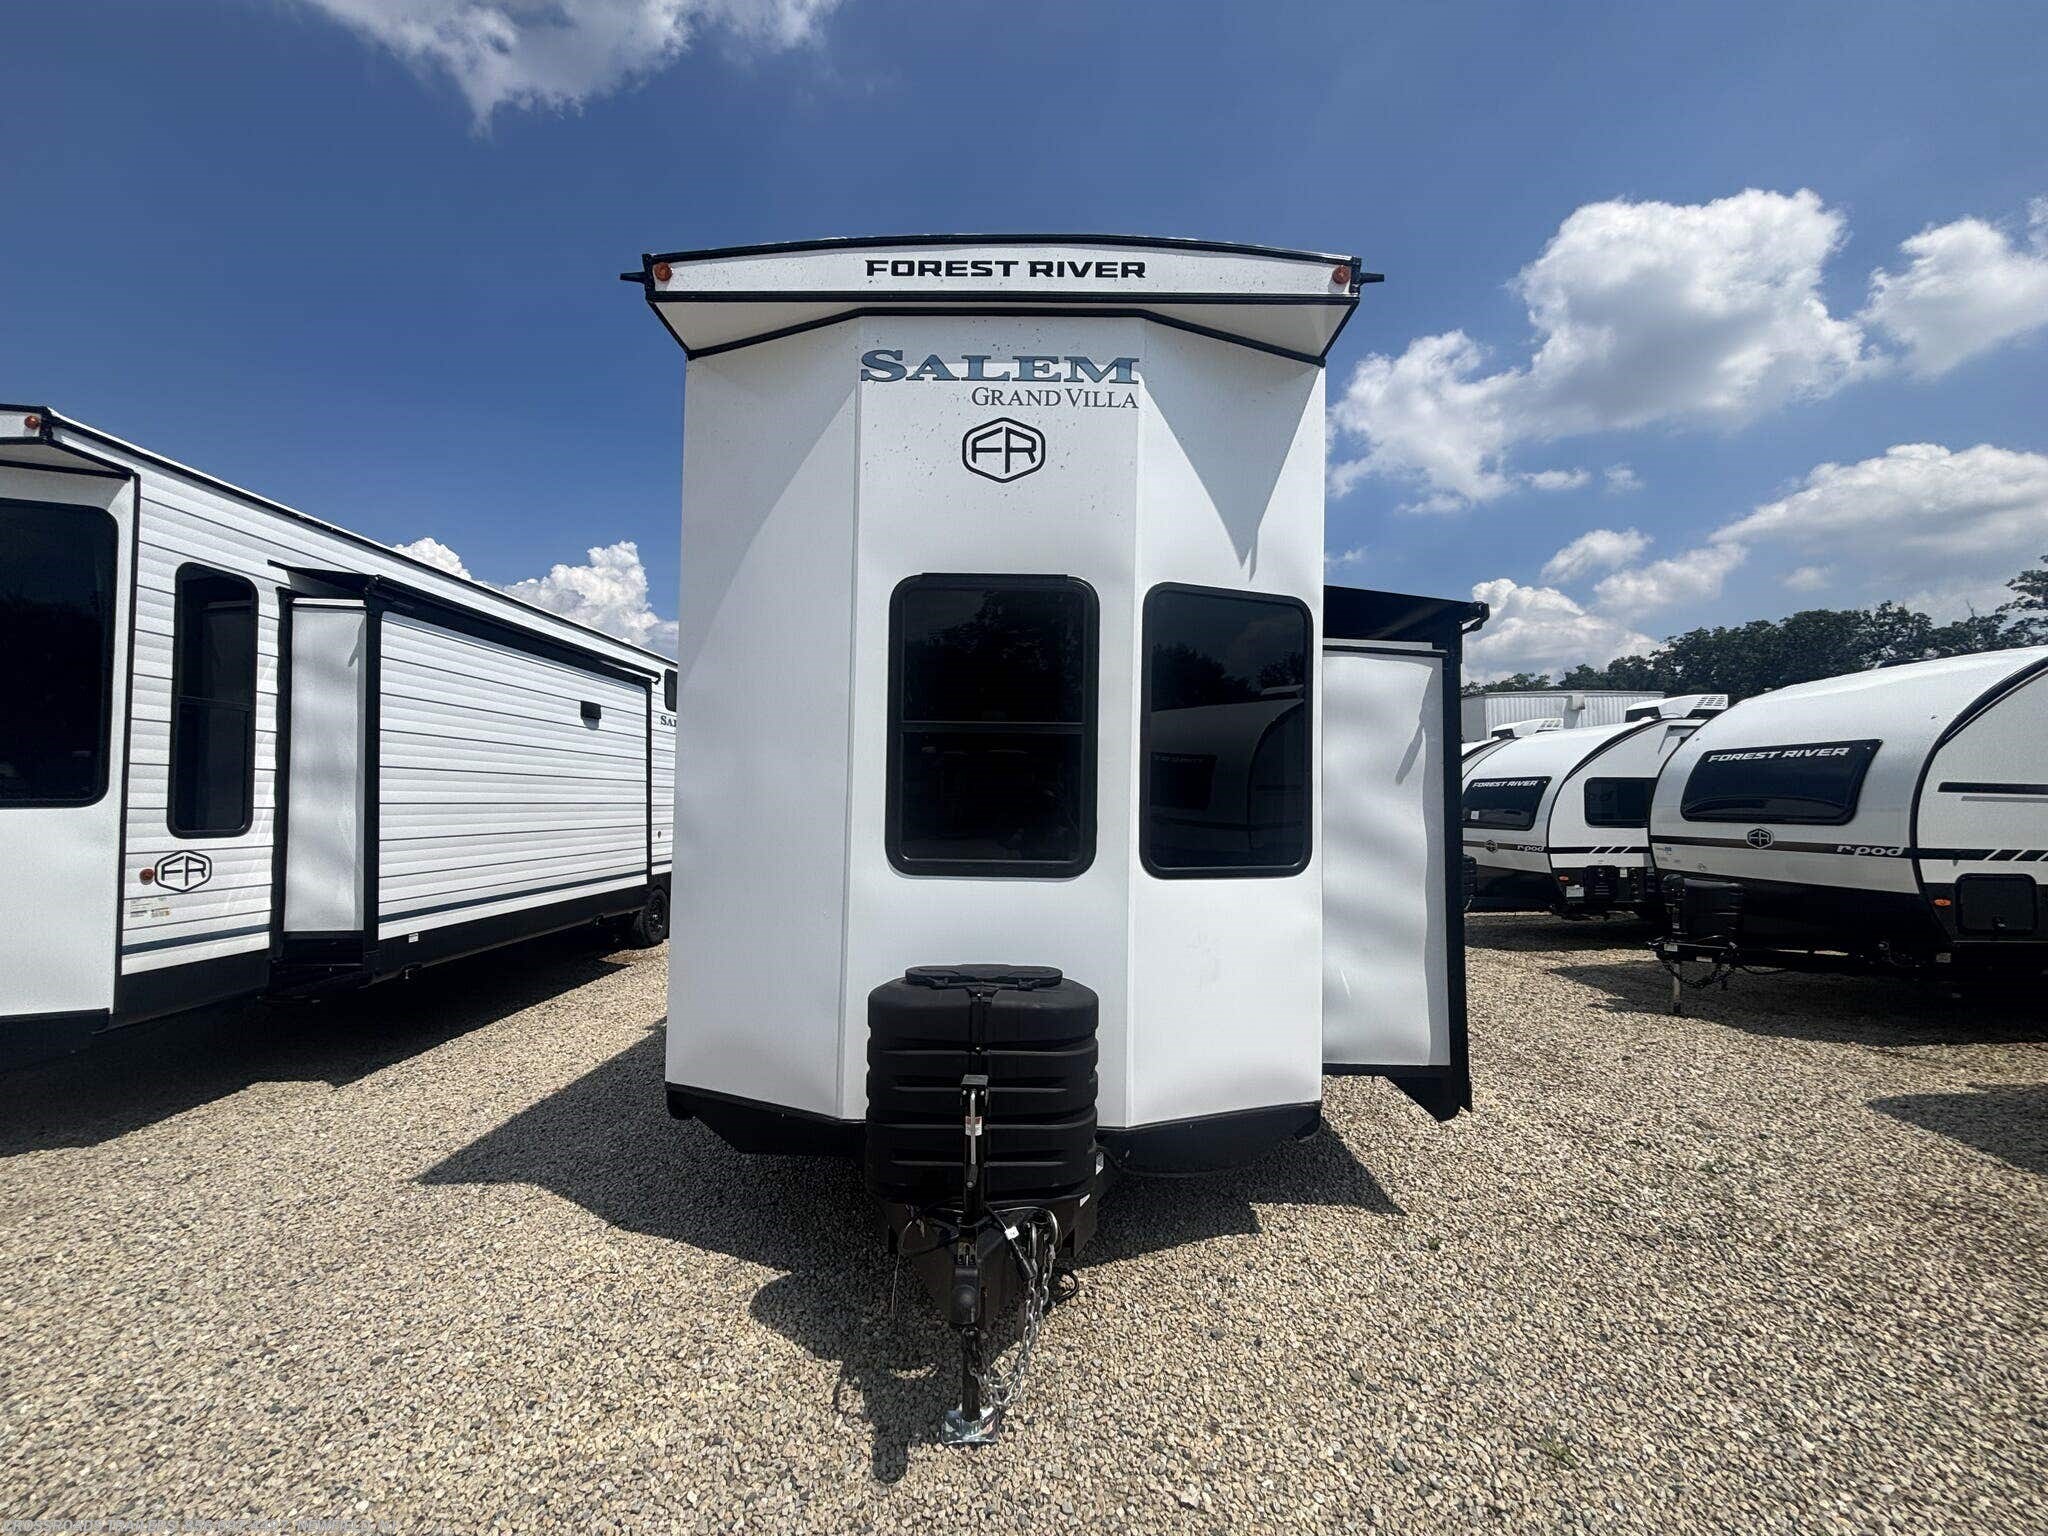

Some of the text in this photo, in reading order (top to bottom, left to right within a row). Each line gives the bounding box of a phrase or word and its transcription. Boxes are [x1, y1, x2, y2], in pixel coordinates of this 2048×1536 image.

[865, 260, 1147, 279] FOREST RIVER
[860, 349, 1140, 385] SALEM
[971, 387, 1140, 409] GRAND VILLA
[1708, 747, 1850, 762] FOREST RIVER
